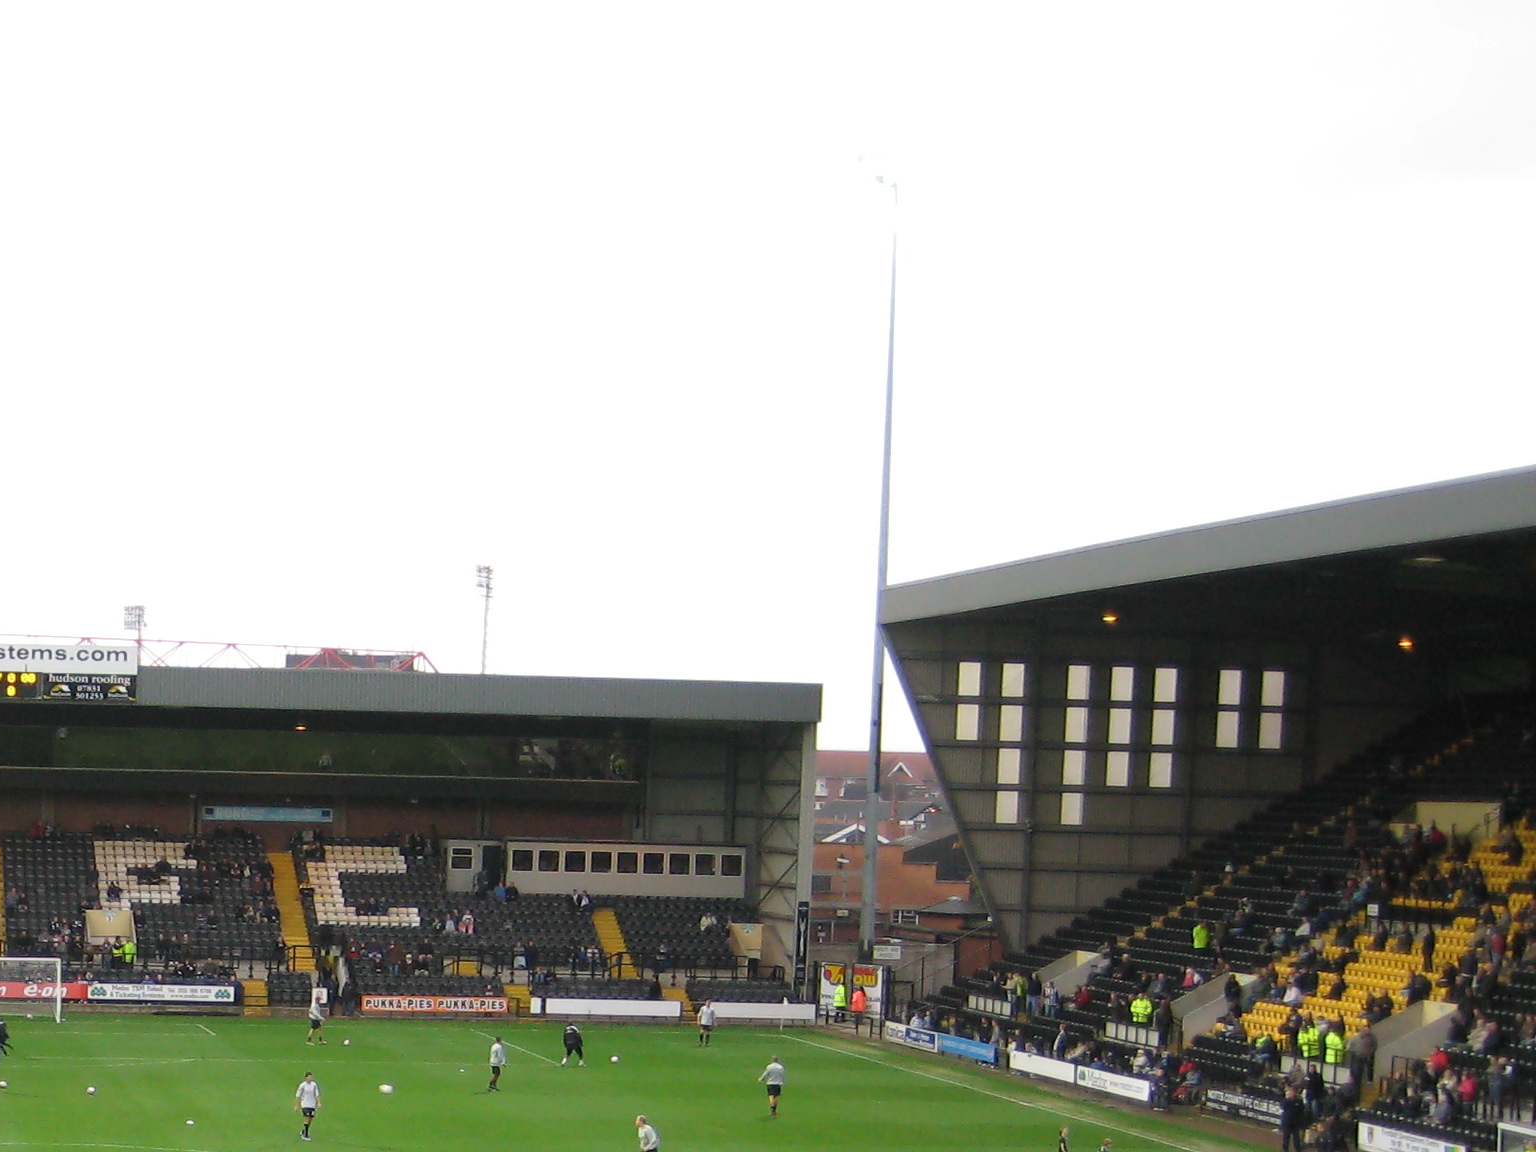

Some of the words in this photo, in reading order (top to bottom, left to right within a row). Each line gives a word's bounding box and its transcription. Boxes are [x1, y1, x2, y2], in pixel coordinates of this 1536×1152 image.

[48, 673, 88, 684] hudson
[91, 675, 131, 686] roofing
[303, 845, 420, 928] C
[365, 998, 433, 1009] PUKKA-PIES
[438, 999, 505, 1010] PUKKA-PIES
